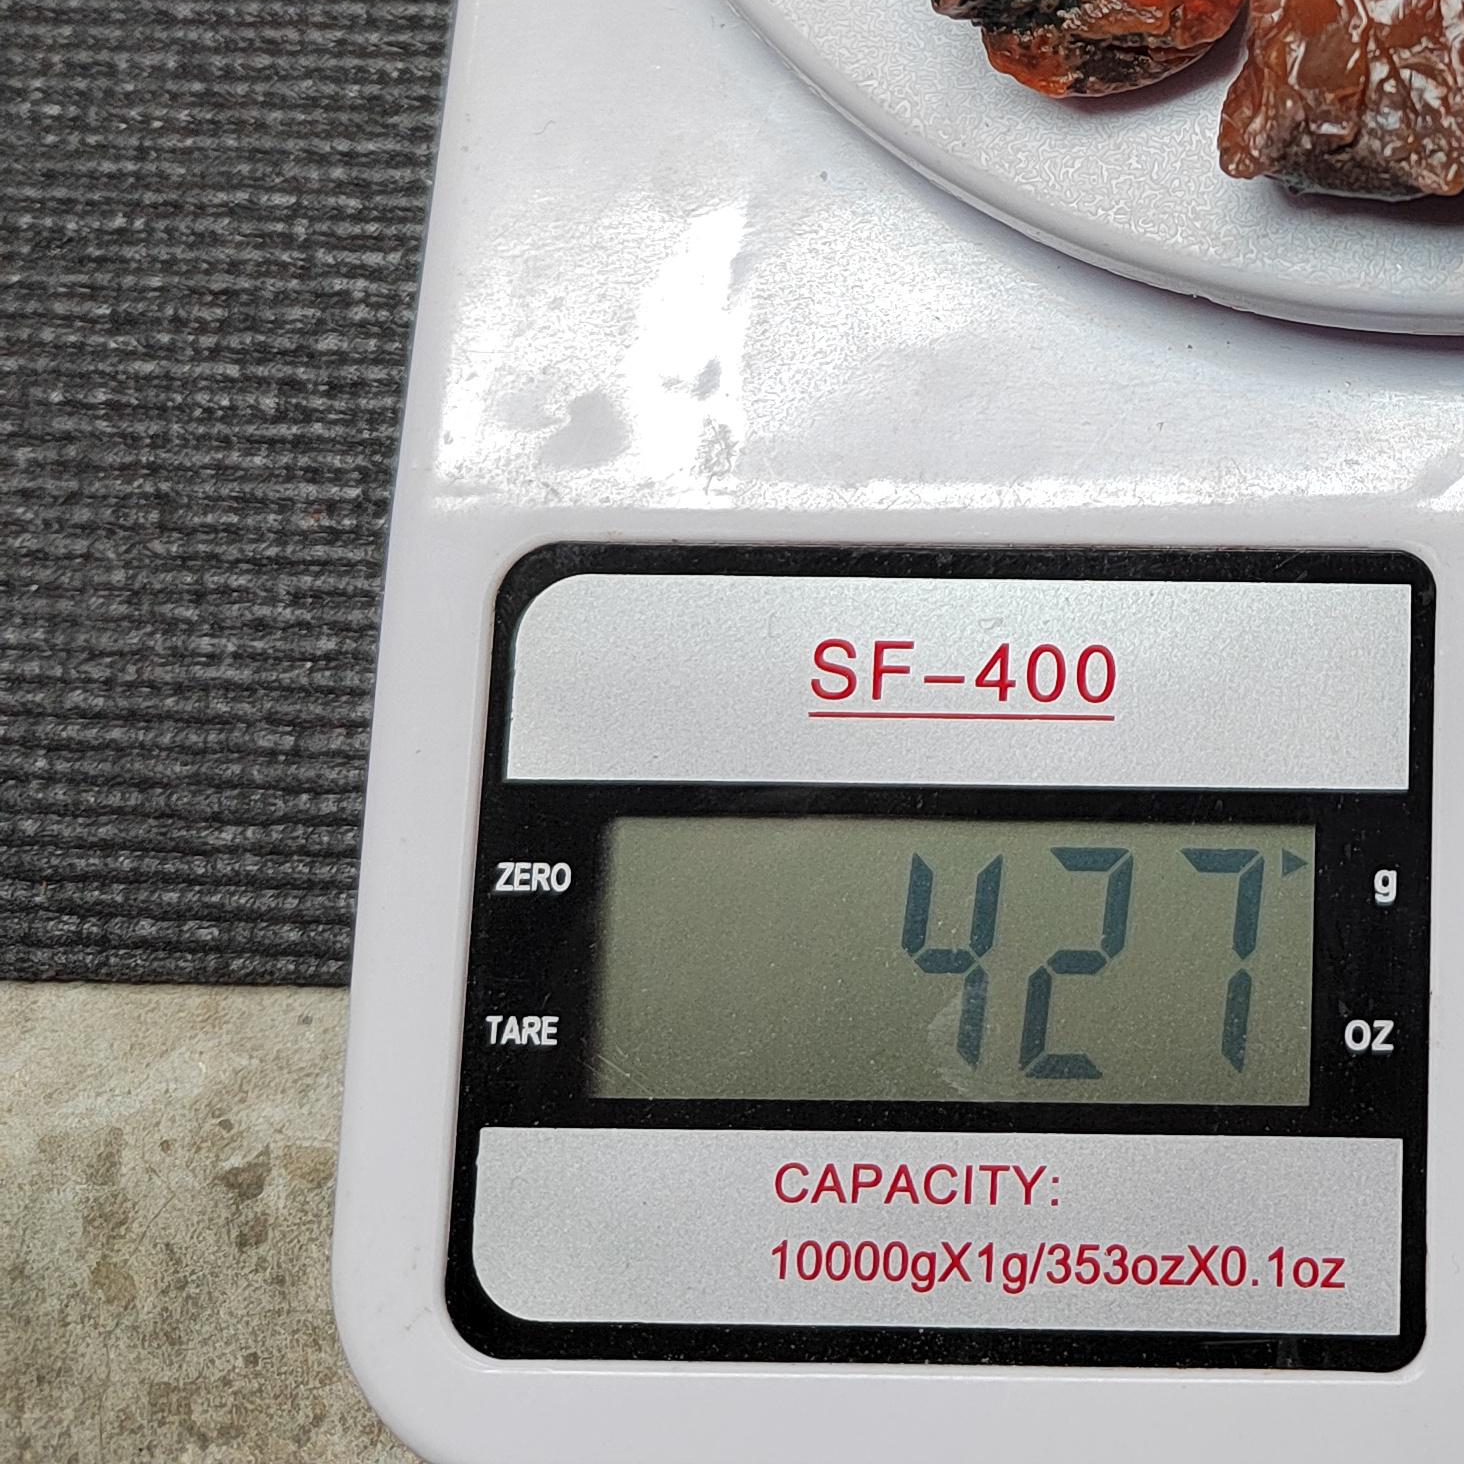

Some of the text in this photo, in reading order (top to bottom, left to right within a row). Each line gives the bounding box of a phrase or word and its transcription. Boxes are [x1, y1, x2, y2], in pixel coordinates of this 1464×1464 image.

[494, 861, 573, 893] ZERO
[1371, 868, 1398, 904] g
[900, 846, 1265, 1080] 427
[485, 1015, 560, 1047] TARE
[772, 1162, 1062, 1208] CAPACITY:
